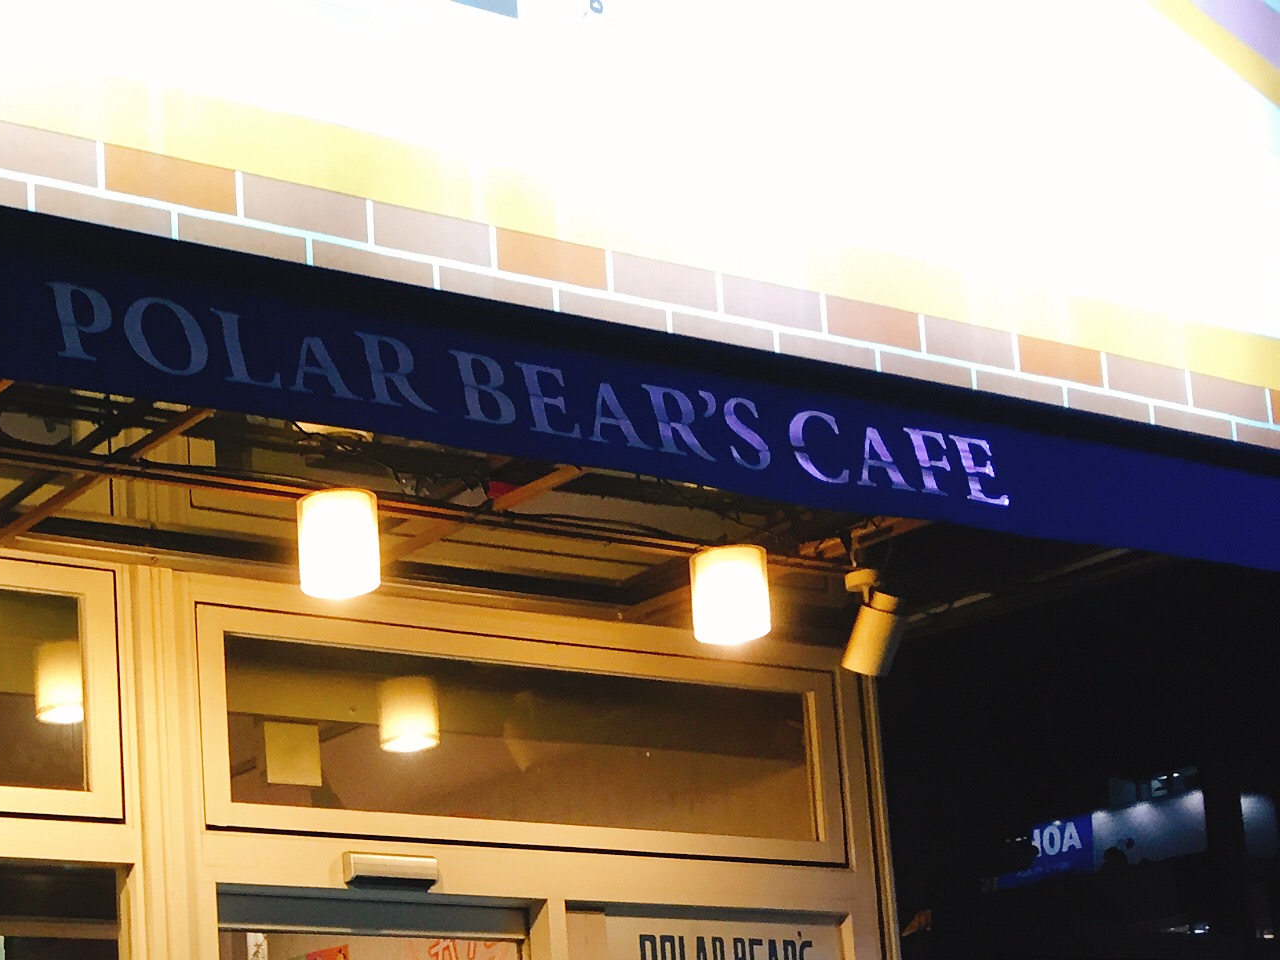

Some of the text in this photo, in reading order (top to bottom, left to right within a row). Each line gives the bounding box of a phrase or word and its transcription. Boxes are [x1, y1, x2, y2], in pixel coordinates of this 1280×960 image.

[46, 281, 1010, 507] POLAR BEAR'S CAFE
